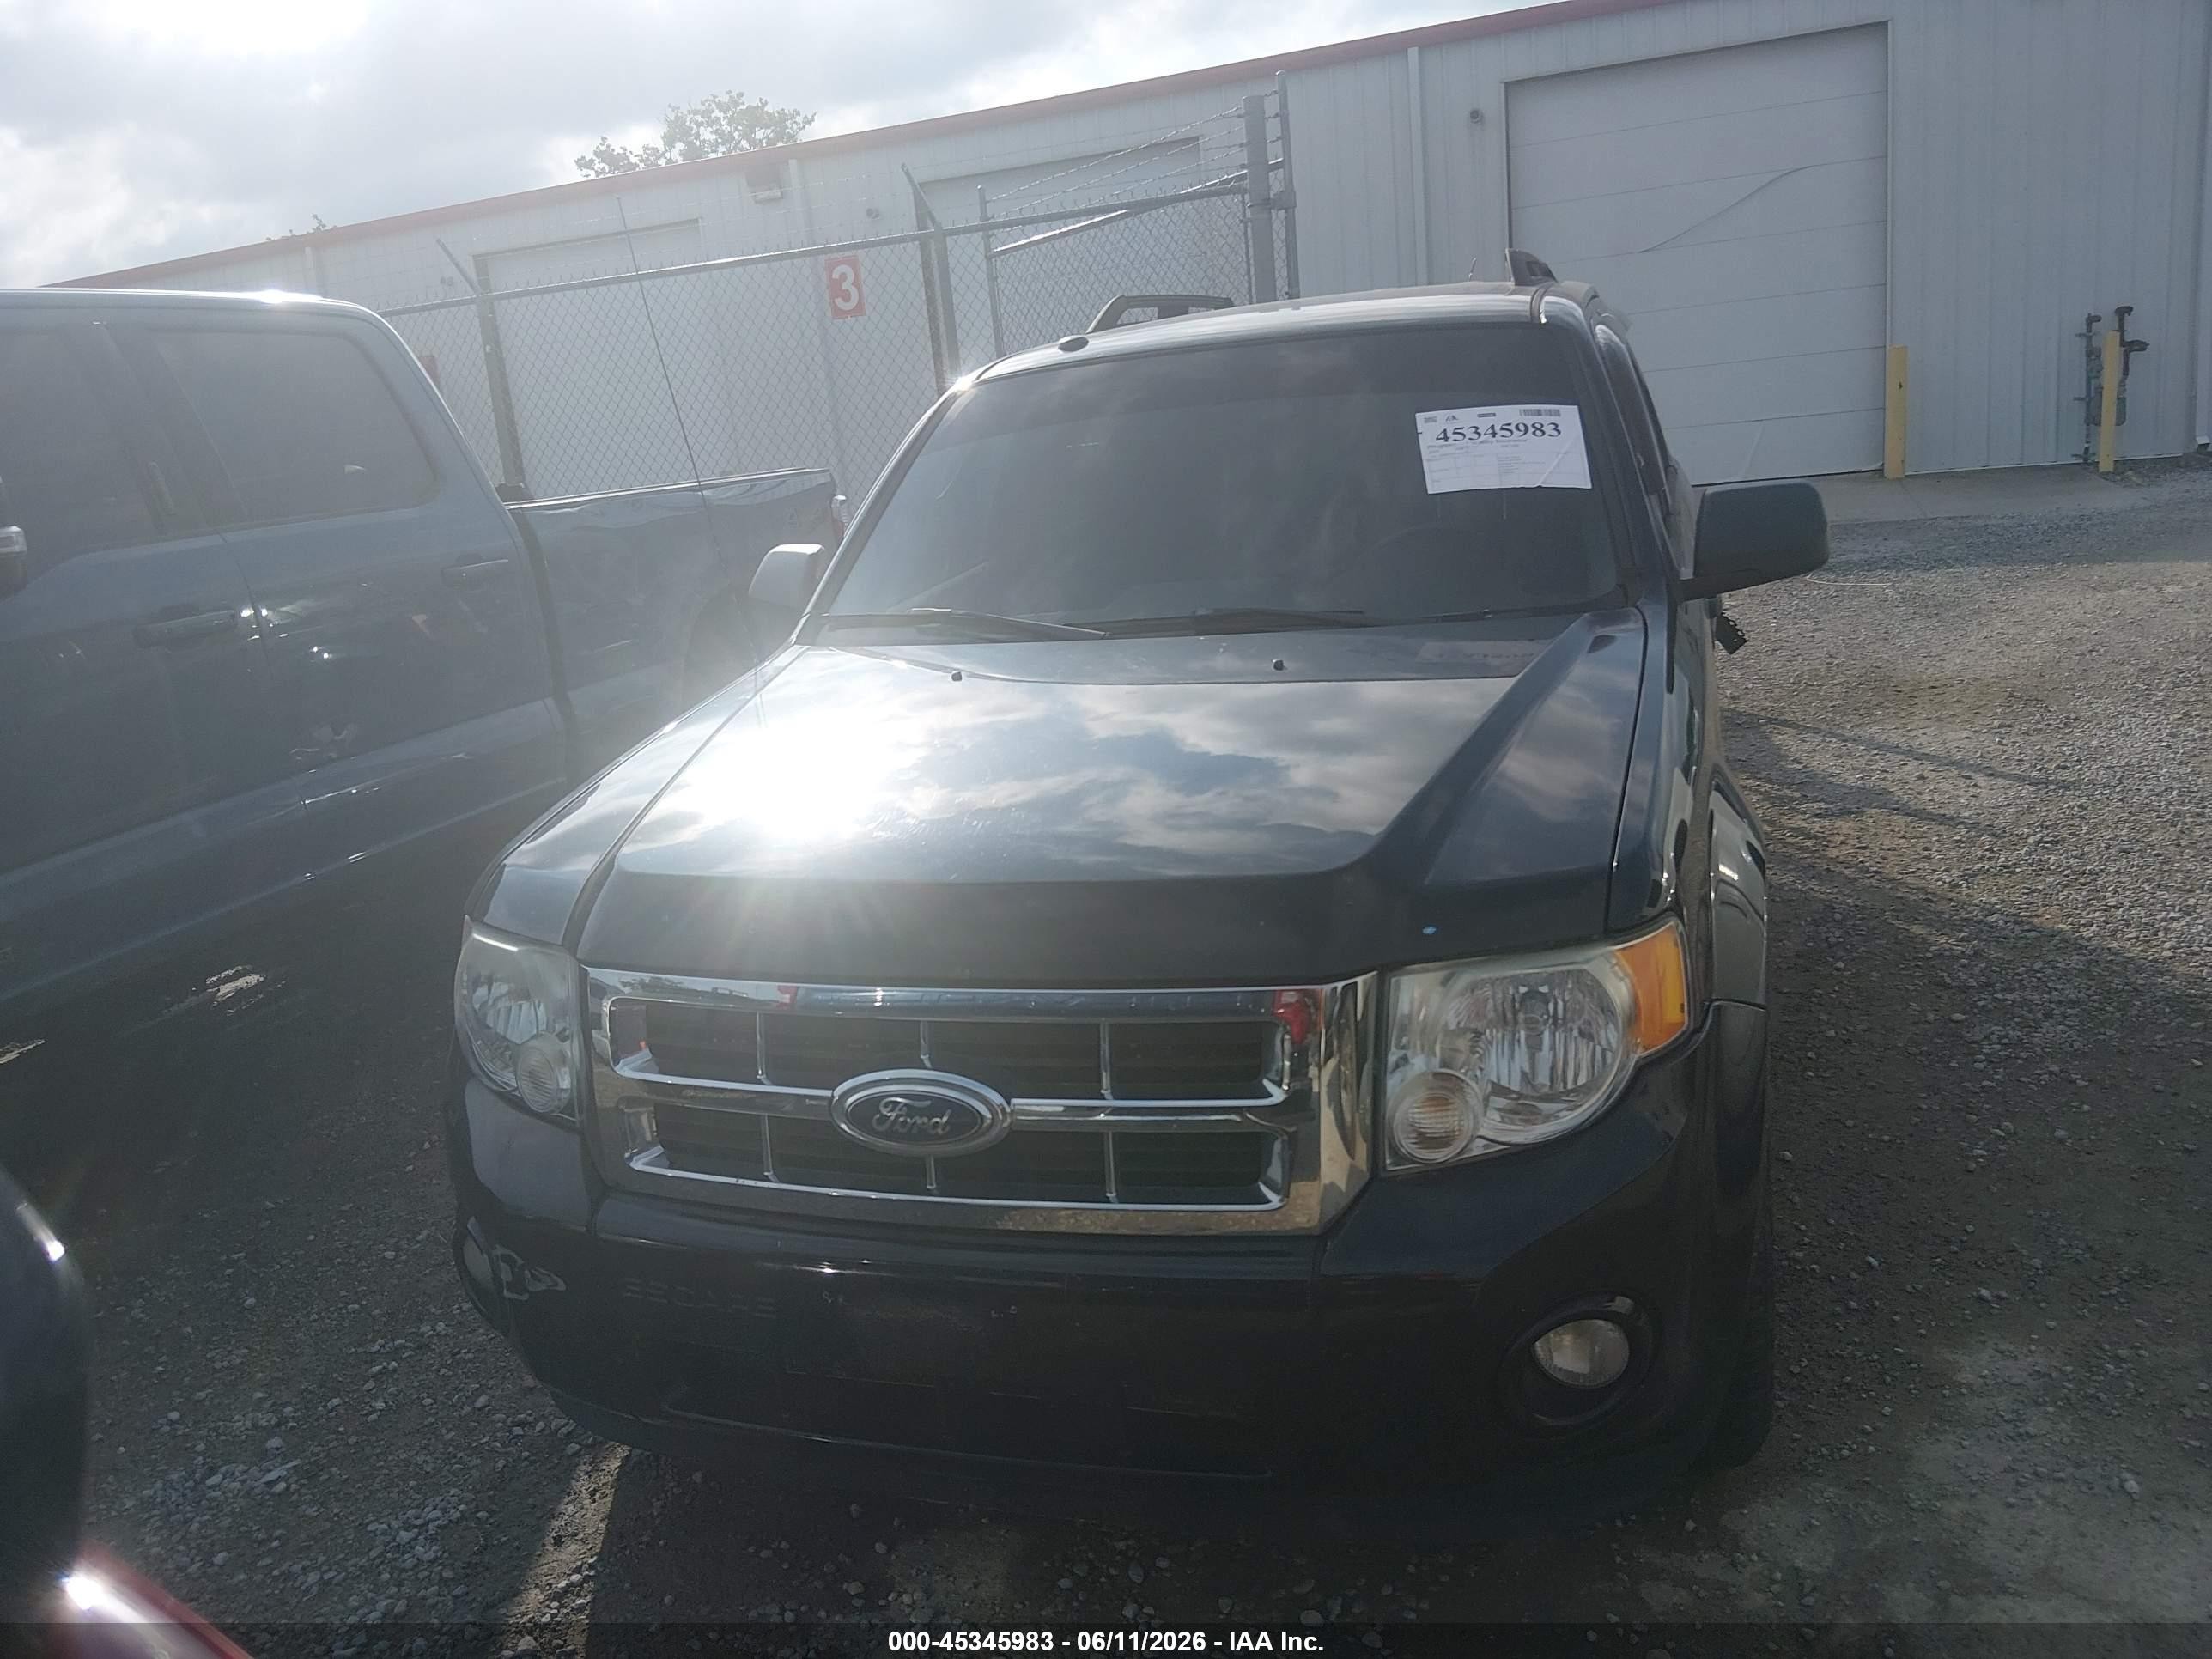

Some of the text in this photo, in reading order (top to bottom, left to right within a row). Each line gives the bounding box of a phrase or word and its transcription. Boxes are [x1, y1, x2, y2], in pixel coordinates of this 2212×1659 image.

[832, 264, 859, 310] 3
[1436, 422, 1561, 442] 45345983
[872, 1097, 951, 1135] Ford
